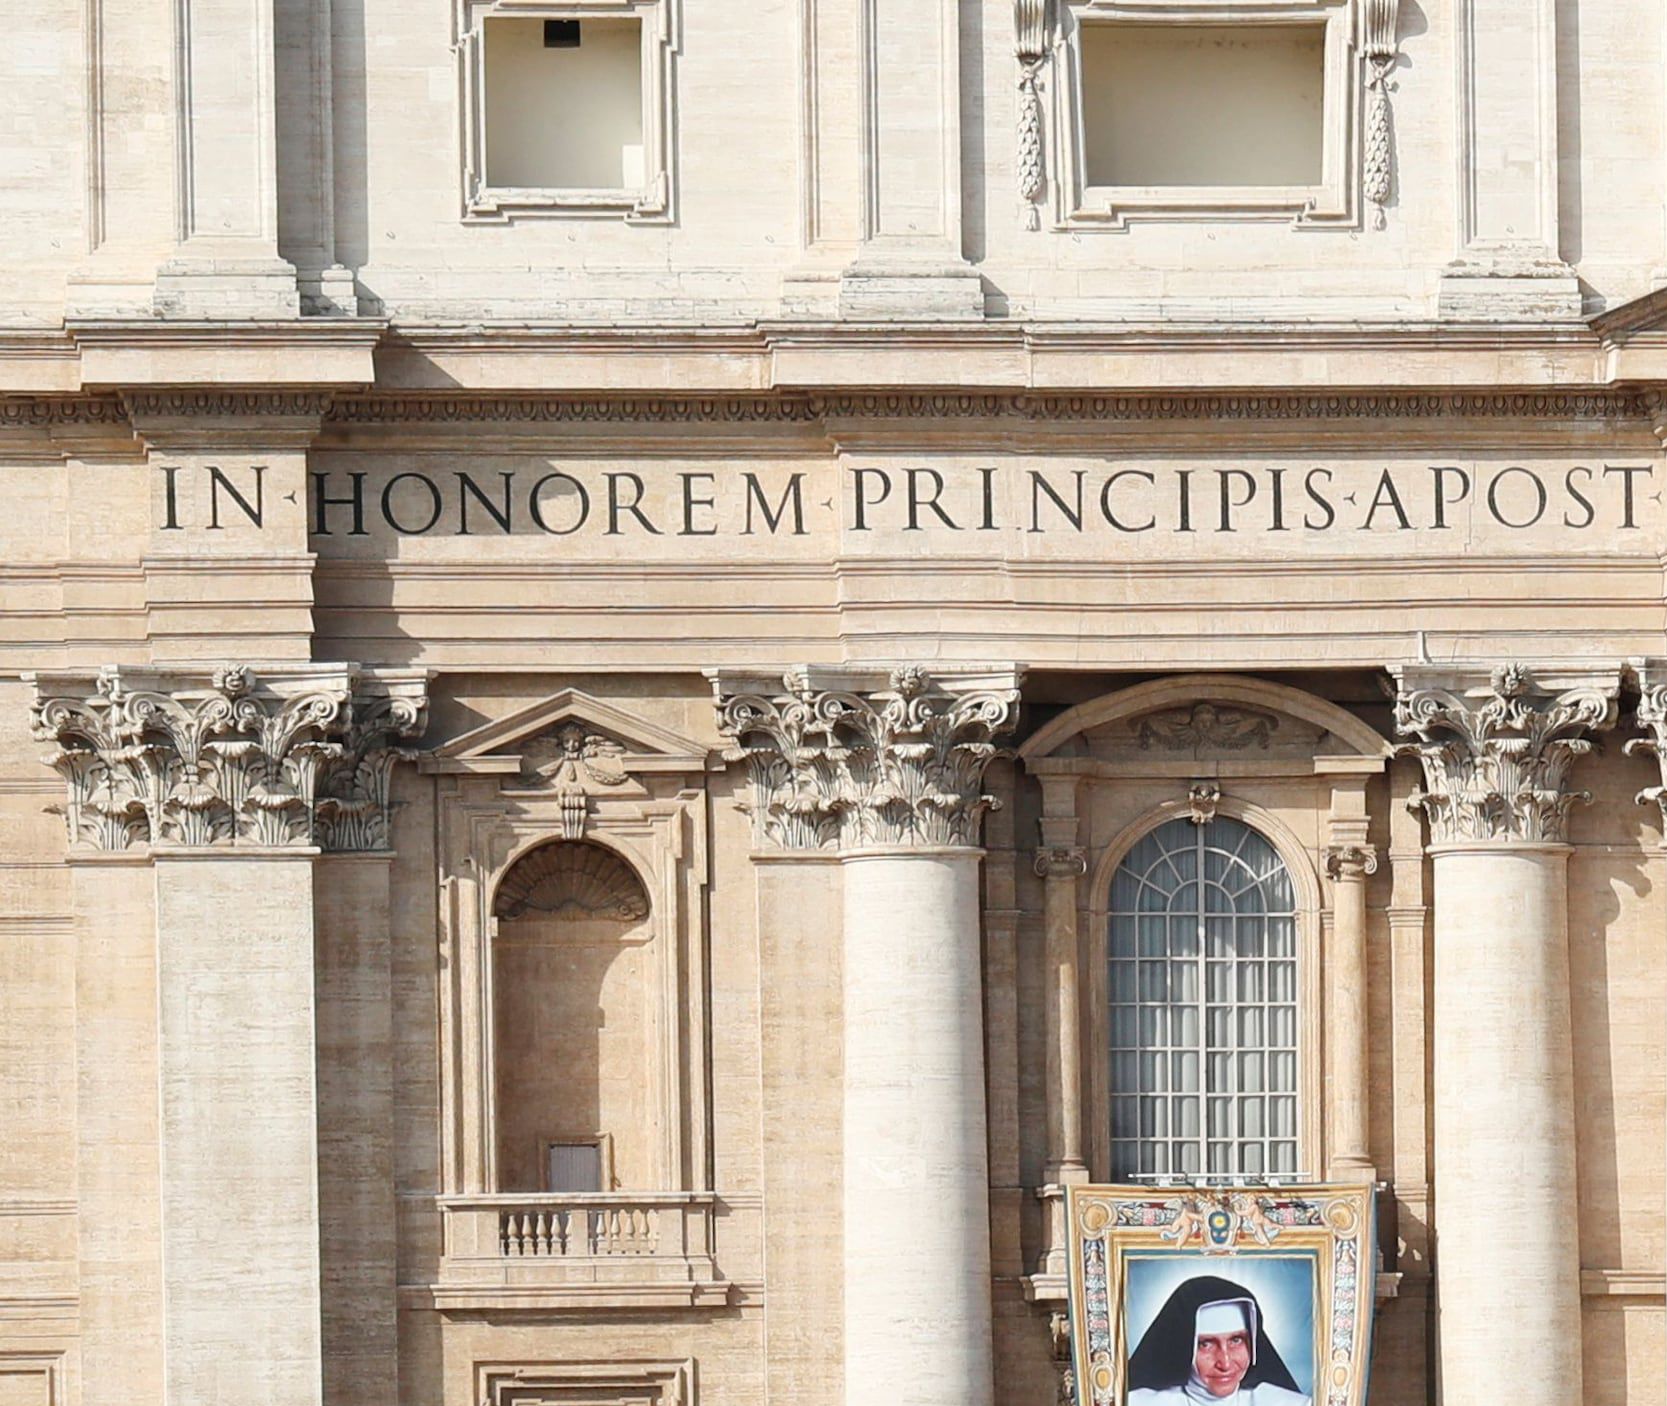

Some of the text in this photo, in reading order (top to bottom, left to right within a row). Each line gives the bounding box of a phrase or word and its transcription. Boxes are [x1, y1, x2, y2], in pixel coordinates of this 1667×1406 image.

[158, 466, 266, 532] IN
[307, 471, 811, 537] HONOREM
[847, 467, 1336, 534] PRINCIPIS
[1355, 465, 1654, 532] APOST
